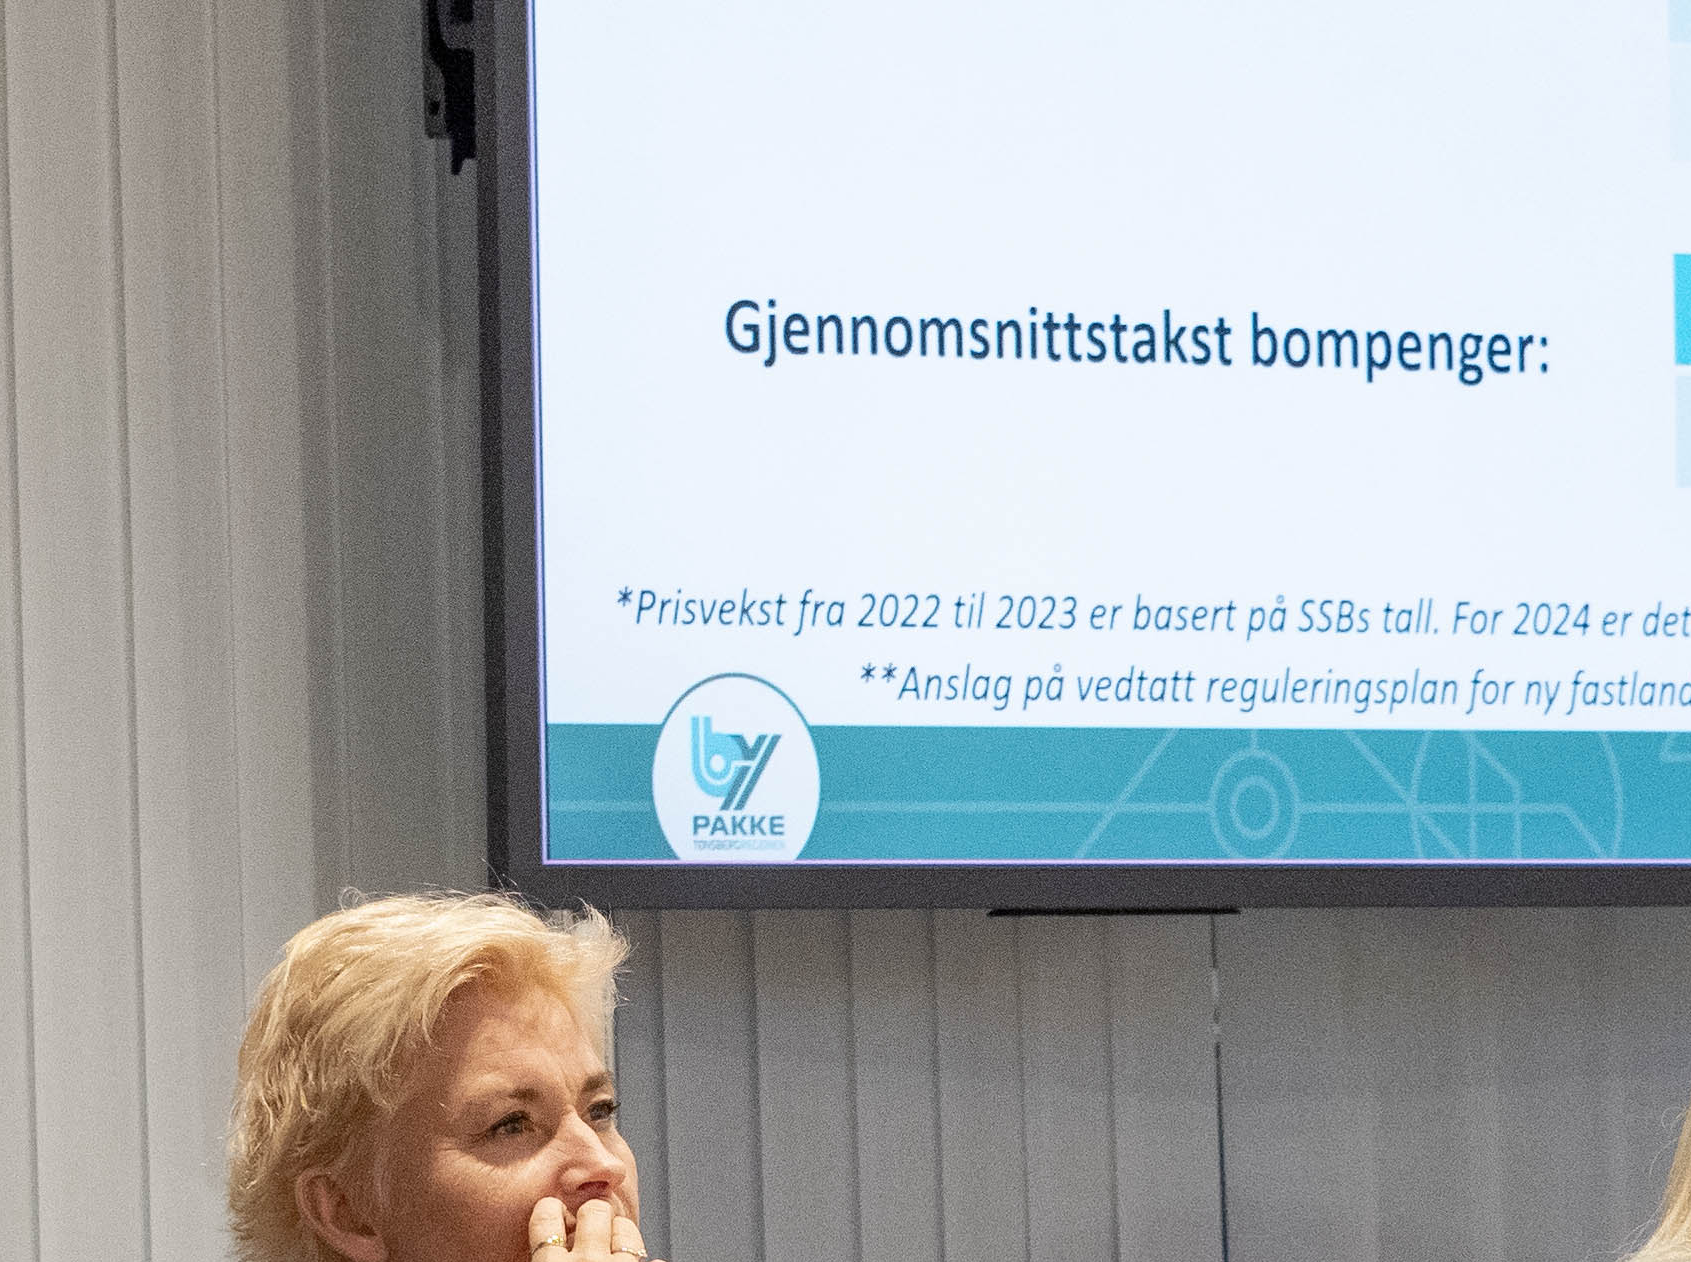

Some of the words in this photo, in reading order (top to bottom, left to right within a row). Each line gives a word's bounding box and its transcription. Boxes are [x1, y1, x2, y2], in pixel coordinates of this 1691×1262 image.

[724, 299, 1233, 368] Gjennomsnittstakst
[1251, 311, 1549, 387] bompenger:
[793, 589, 845, 637] fra
[857, 593, 941, 629] 2022
[954, 592, 985, 630] til
[995, 595, 1077, 631] 2023
[1089, 604, 1123, 631] er
[1133, 593, 1237, 633] basert
[1246, 594, 1288, 642] på
[1297, 599, 1370, 634] SSBs
[1382, 598, 1439, 635] tall.
[1452, 601, 1503, 636] For
[1512, 602, 1590, 637] 2024
[1601, 611, 1633, 638] er
[1023, 663, 1065, 711] på
[1077, 665, 1197, 703] vedtatt
[1206, 667, 1459, 714] reguleringsplan
[1464, 668, 1515, 715] for
[1524, 680, 1562, 715] ny
[693, 815, 786, 837] PAKKE
